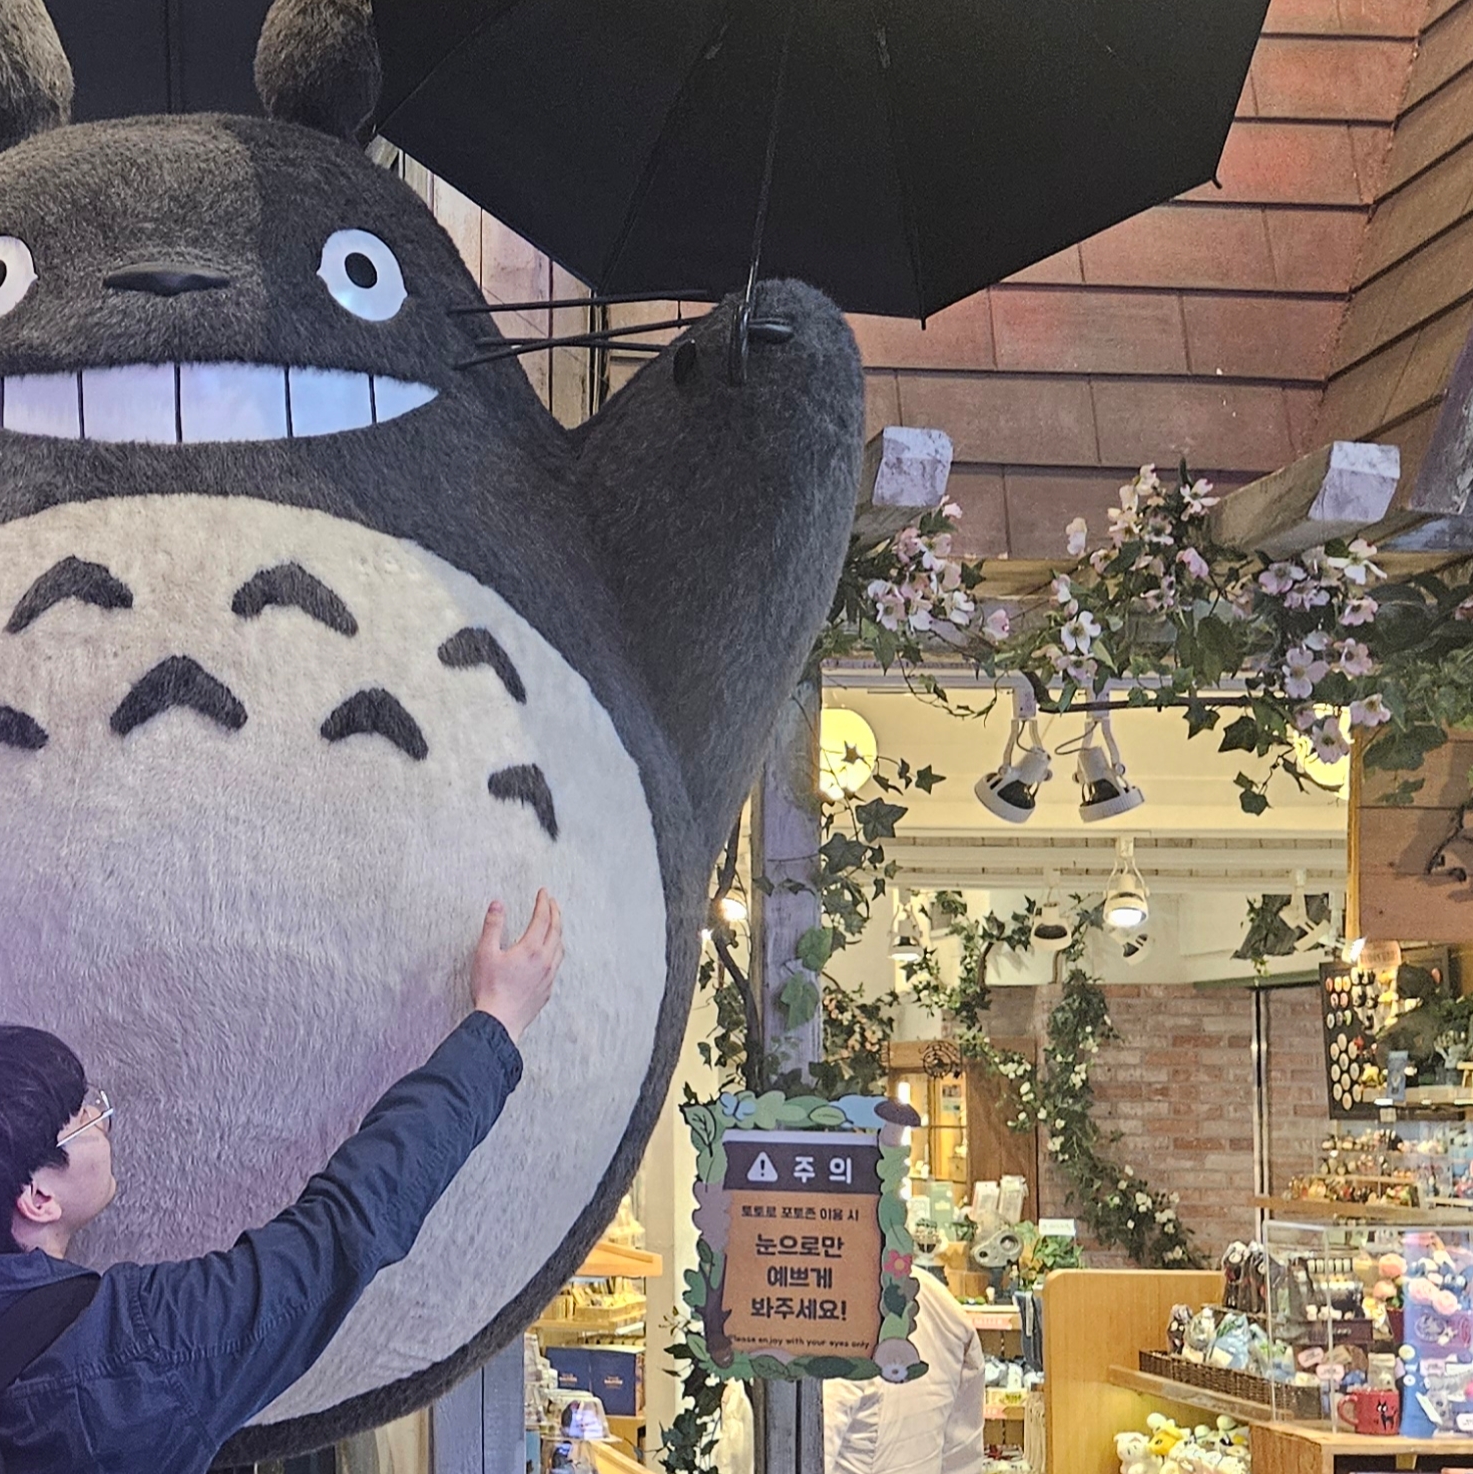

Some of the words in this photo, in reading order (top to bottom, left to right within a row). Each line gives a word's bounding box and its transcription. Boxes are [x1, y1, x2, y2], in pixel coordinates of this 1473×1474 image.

[741, 1206, 777, 1218] 토토로
[782, 1207, 816, 1220] 포토존
[820, 1208, 843, 1221] 이용
[847, 1209, 859, 1221] 시
[755, 1233, 844, 1258] 눈으로만
[767, 1265, 833, 1288] 예쁘게
[751, 1296, 847, 1321] 봐주세요!
[758, 1336, 783, 1346] enjoy
[786, 1337, 805, 1346] with
[806, 1339, 826, 1347] your
[829, 1340, 850, 1349] eyes
[851, 1340, 870, 1350] only
